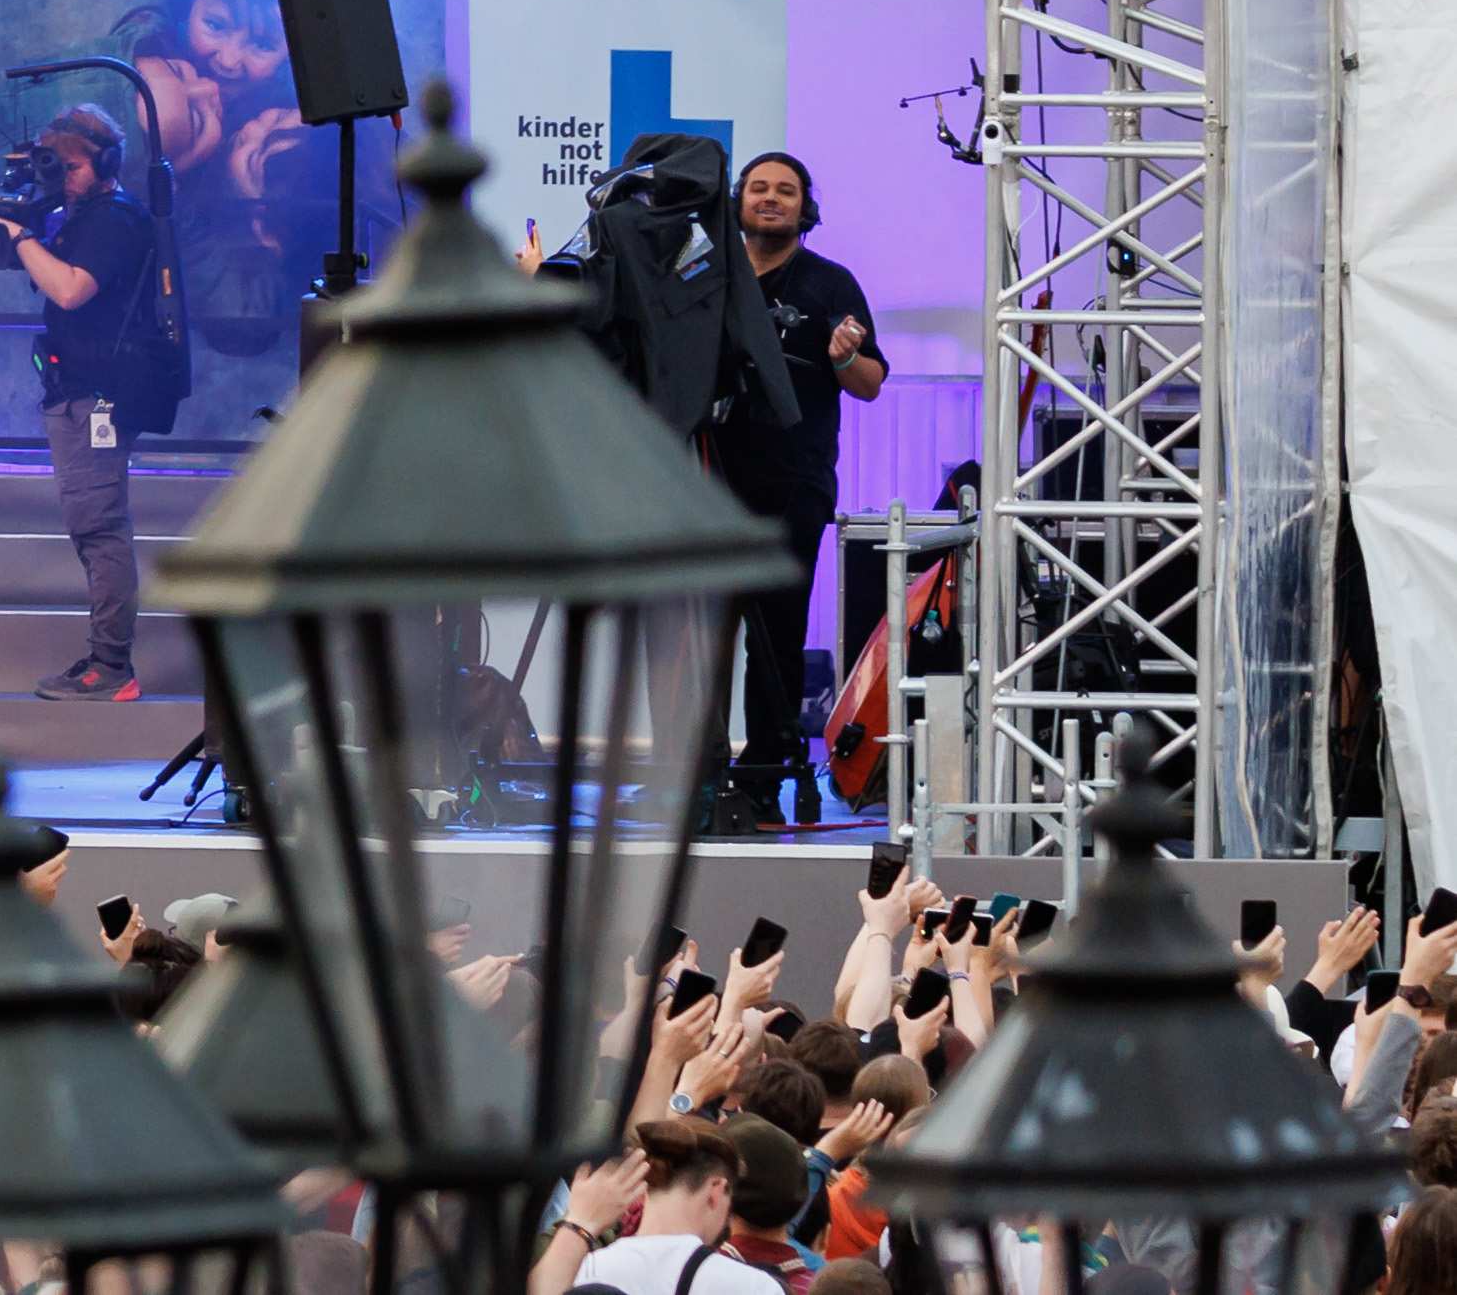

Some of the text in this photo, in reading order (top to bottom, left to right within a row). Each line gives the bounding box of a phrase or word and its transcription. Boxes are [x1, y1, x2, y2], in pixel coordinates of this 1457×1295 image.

[518, 115, 604, 138] kinder
[560, 140, 603, 160] not
[542, 163, 603, 186] hilfe
